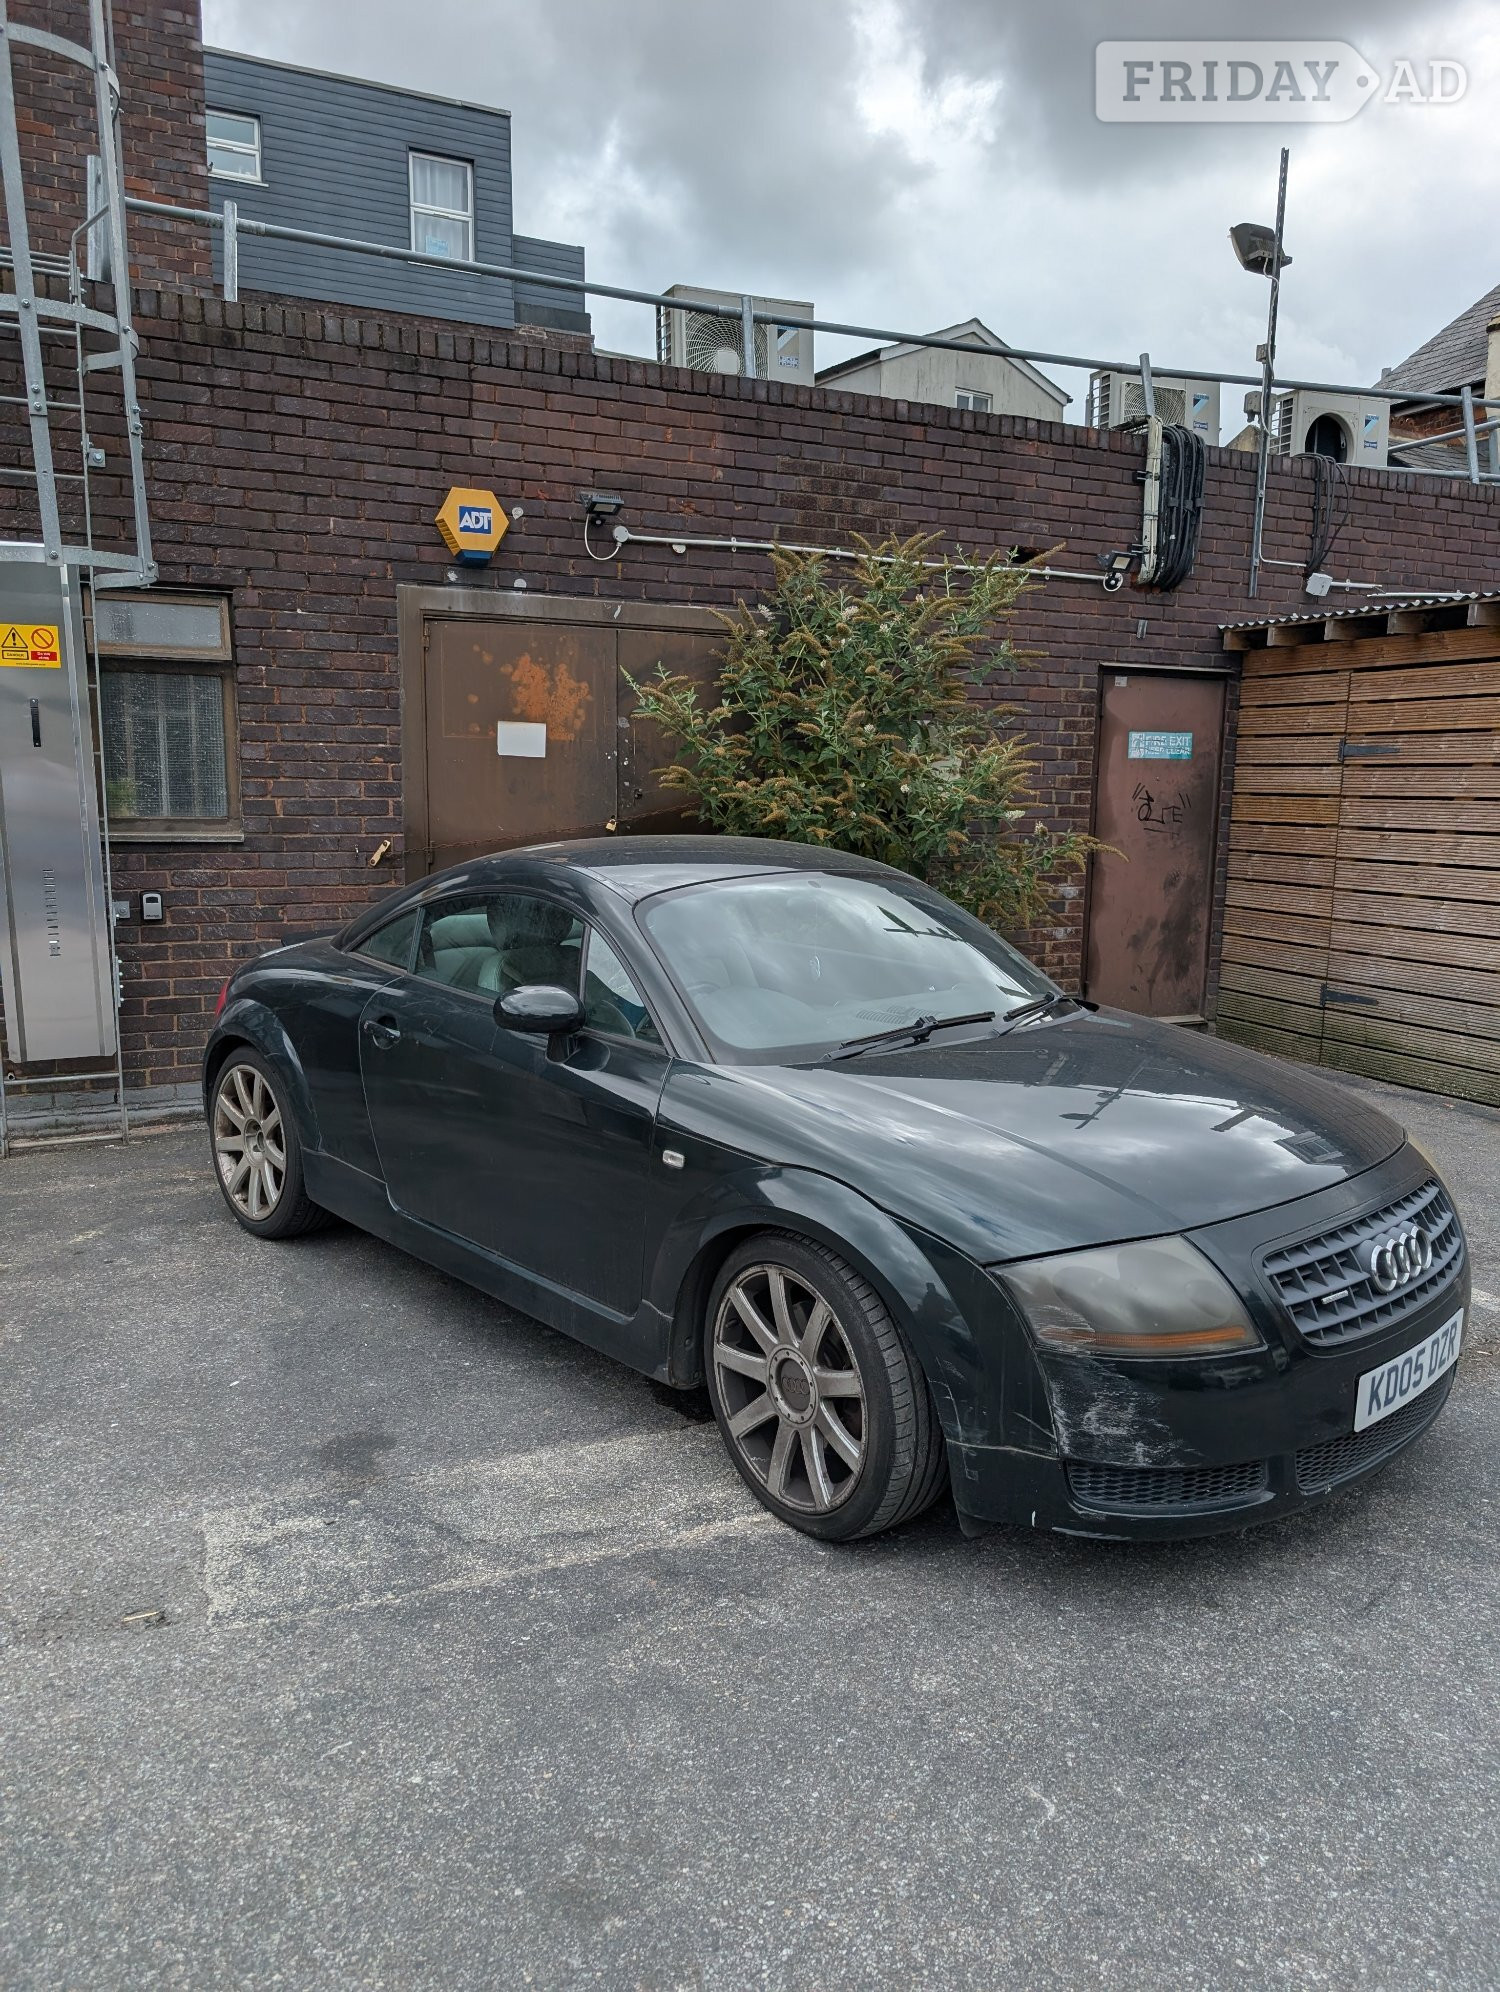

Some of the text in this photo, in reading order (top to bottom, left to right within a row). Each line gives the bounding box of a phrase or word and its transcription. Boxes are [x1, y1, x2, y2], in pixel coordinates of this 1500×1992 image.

[459, 511, 492, 530] ADT
[1145, 735, 1190, 747] FIRE EXIT
[1367, 1320, 1458, 1417] KD05 DZR
